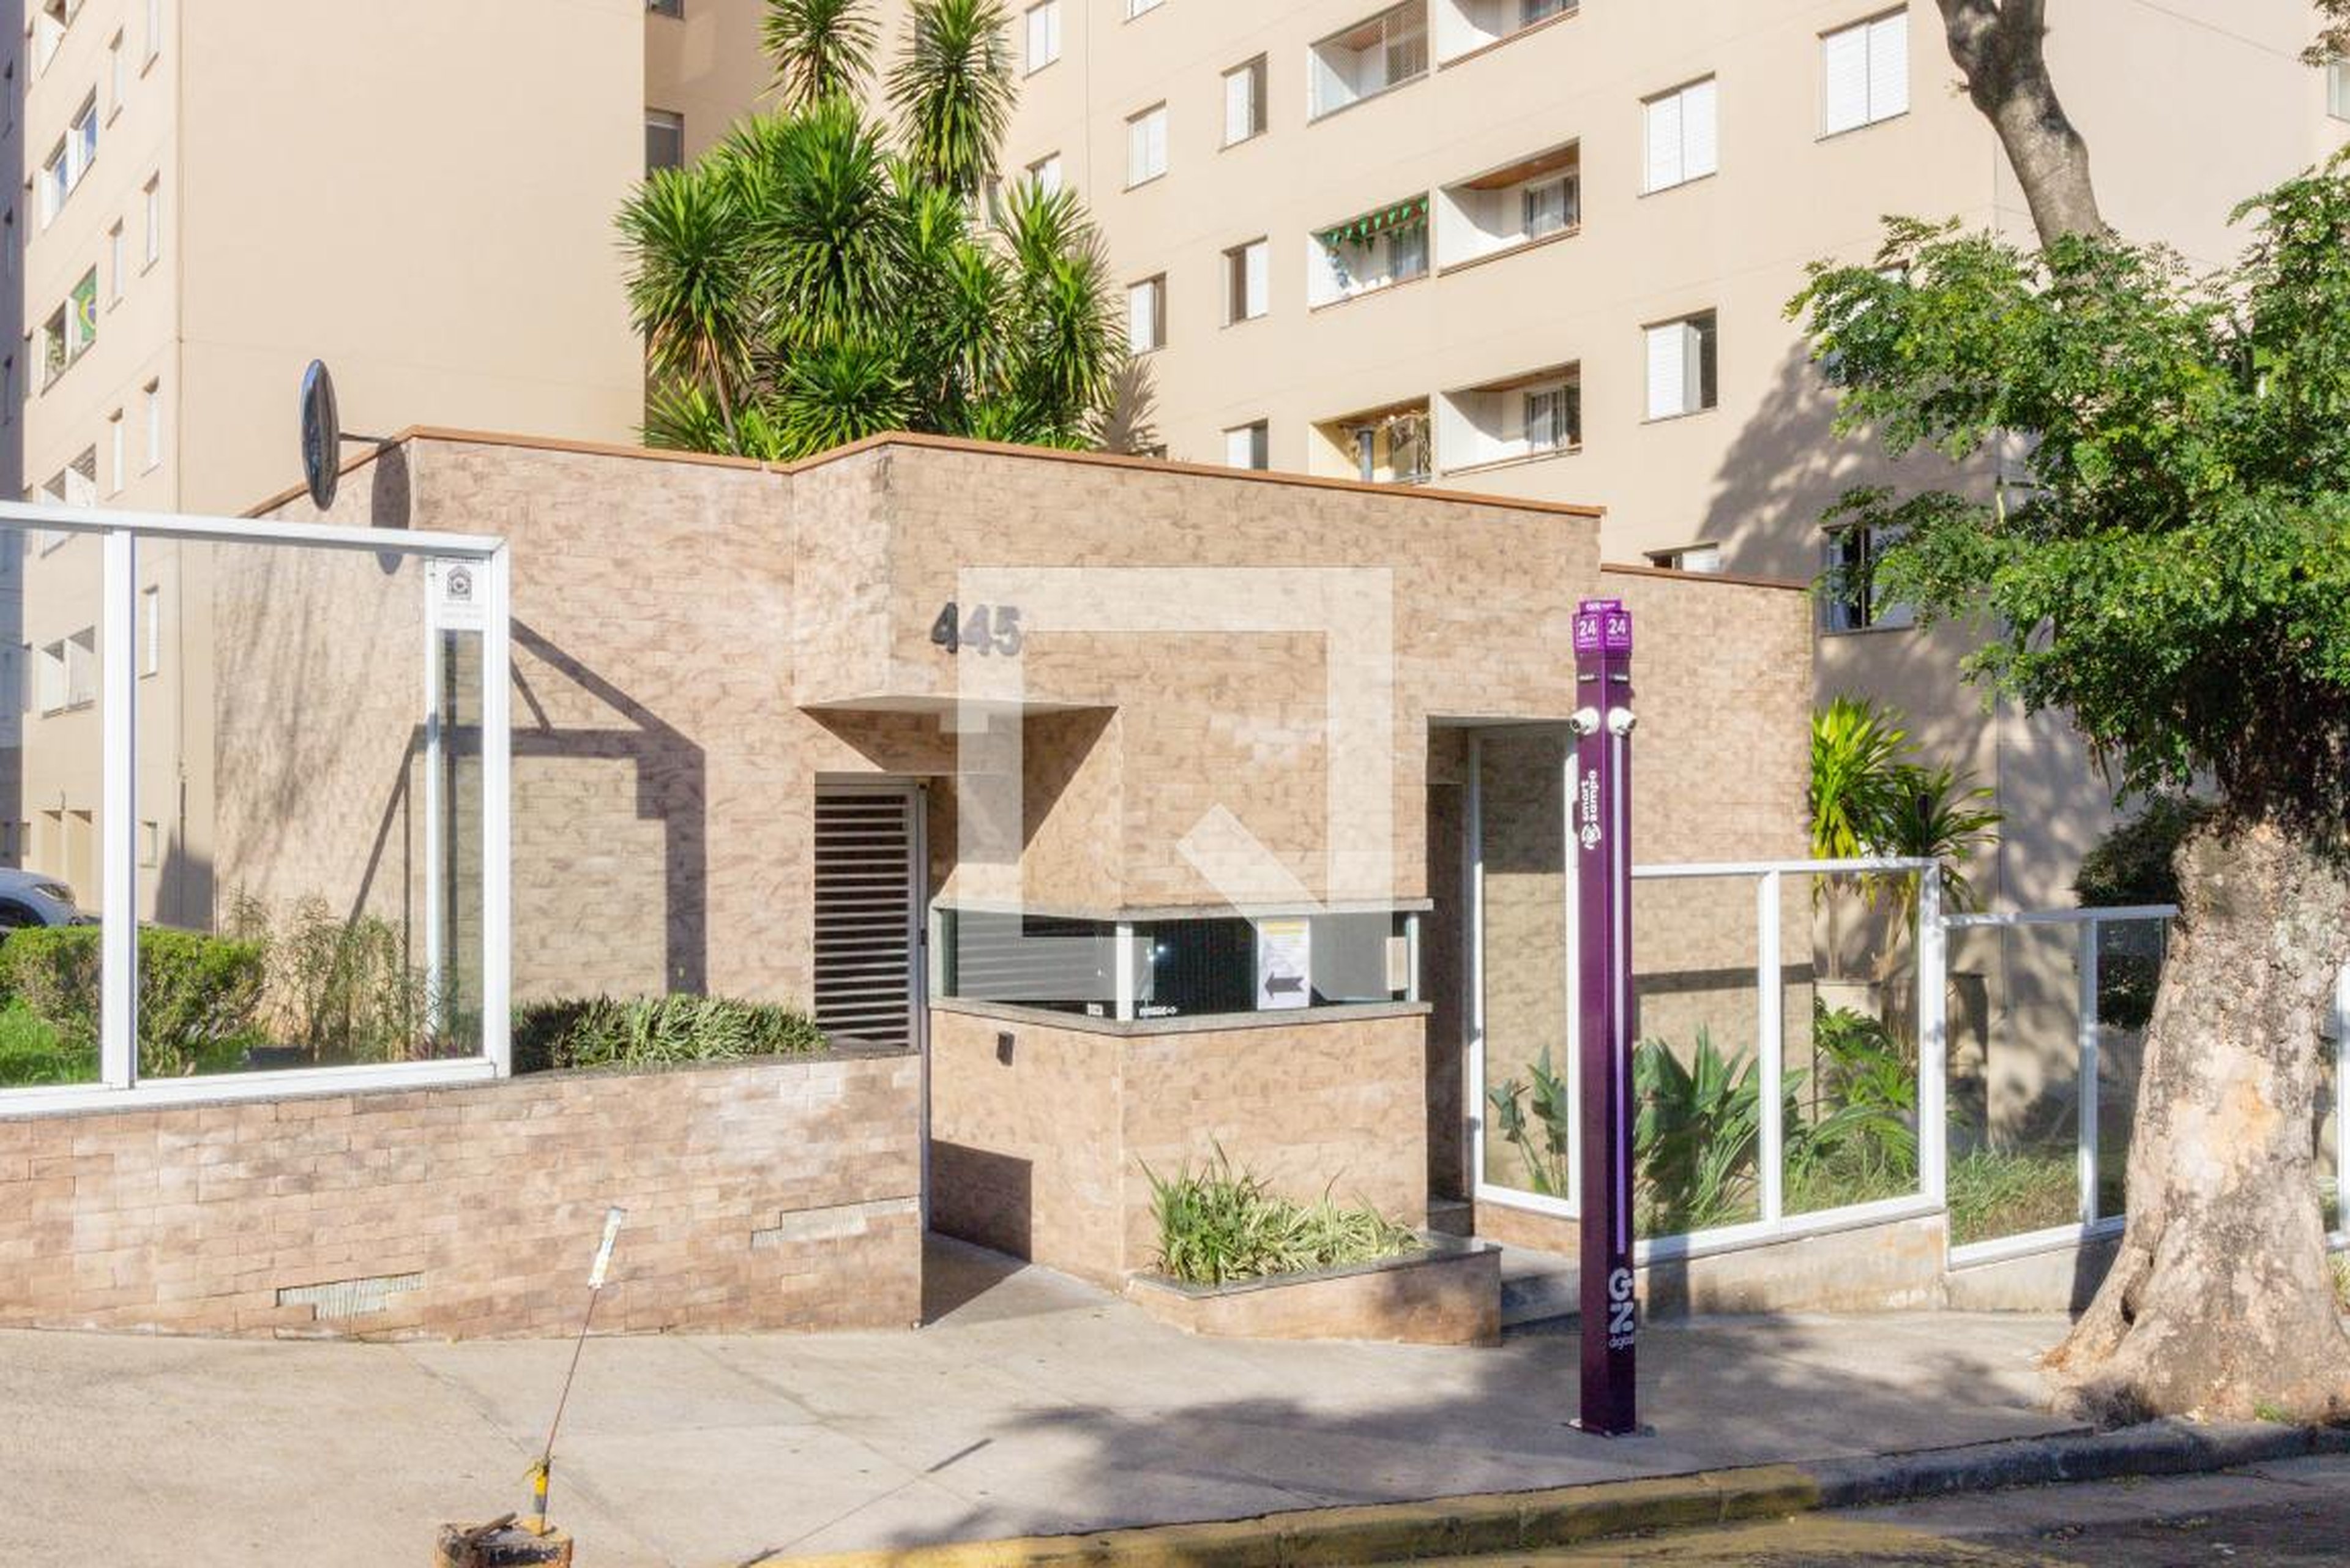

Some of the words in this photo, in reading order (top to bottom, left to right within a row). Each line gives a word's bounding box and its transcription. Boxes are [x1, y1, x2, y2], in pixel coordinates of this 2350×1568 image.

[931, 602, 1022, 656] 445
[1579, 620, 1596, 636] 24
[1608, 618, 1626, 635] 24
